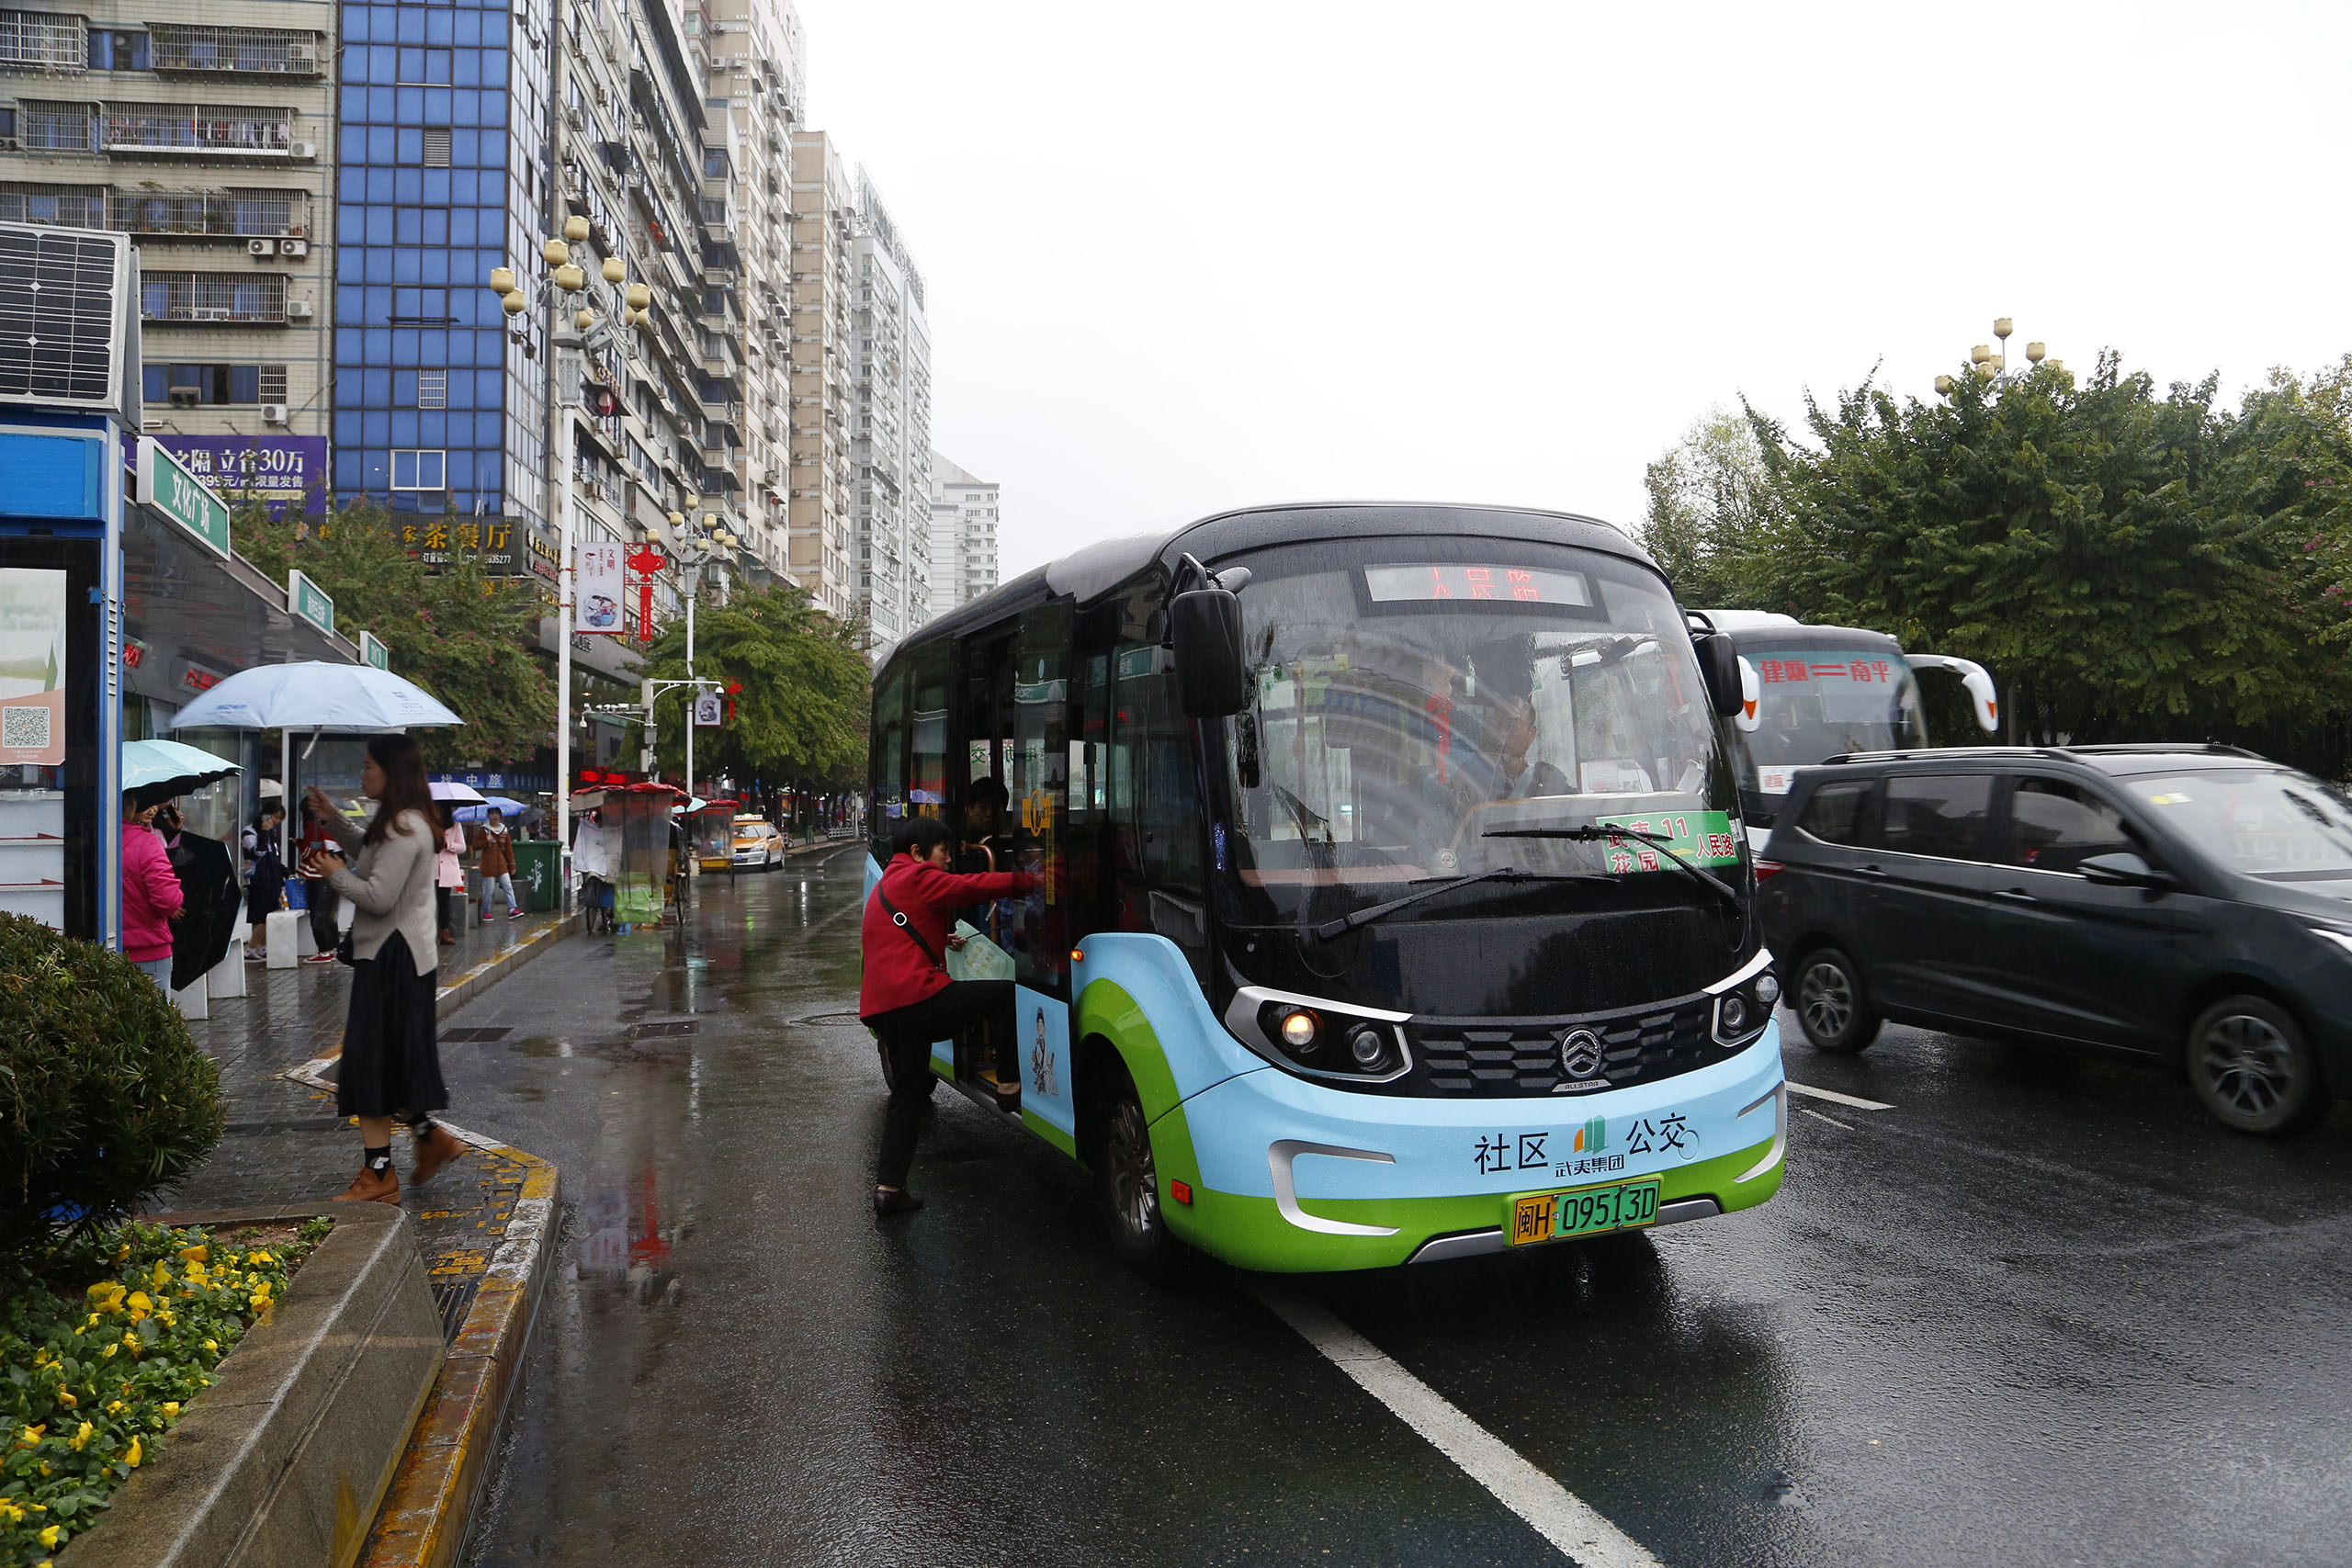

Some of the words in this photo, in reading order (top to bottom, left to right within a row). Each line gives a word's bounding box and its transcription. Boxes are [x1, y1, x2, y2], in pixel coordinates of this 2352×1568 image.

[172, 471, 210, 536] 文化广场
[1661, 817, 1690, 839] 11
[1696, 832, 1736, 859] 人民路
[1611, 850, 1659, 873] 花园
[1565, 1081, 1599, 1090] ALLSTAR
[1474, 1131, 1549, 1176] 社区
[1625, 1111, 1687, 1156] 公交
[1555, 1153, 1625, 1179] 武夷集团
